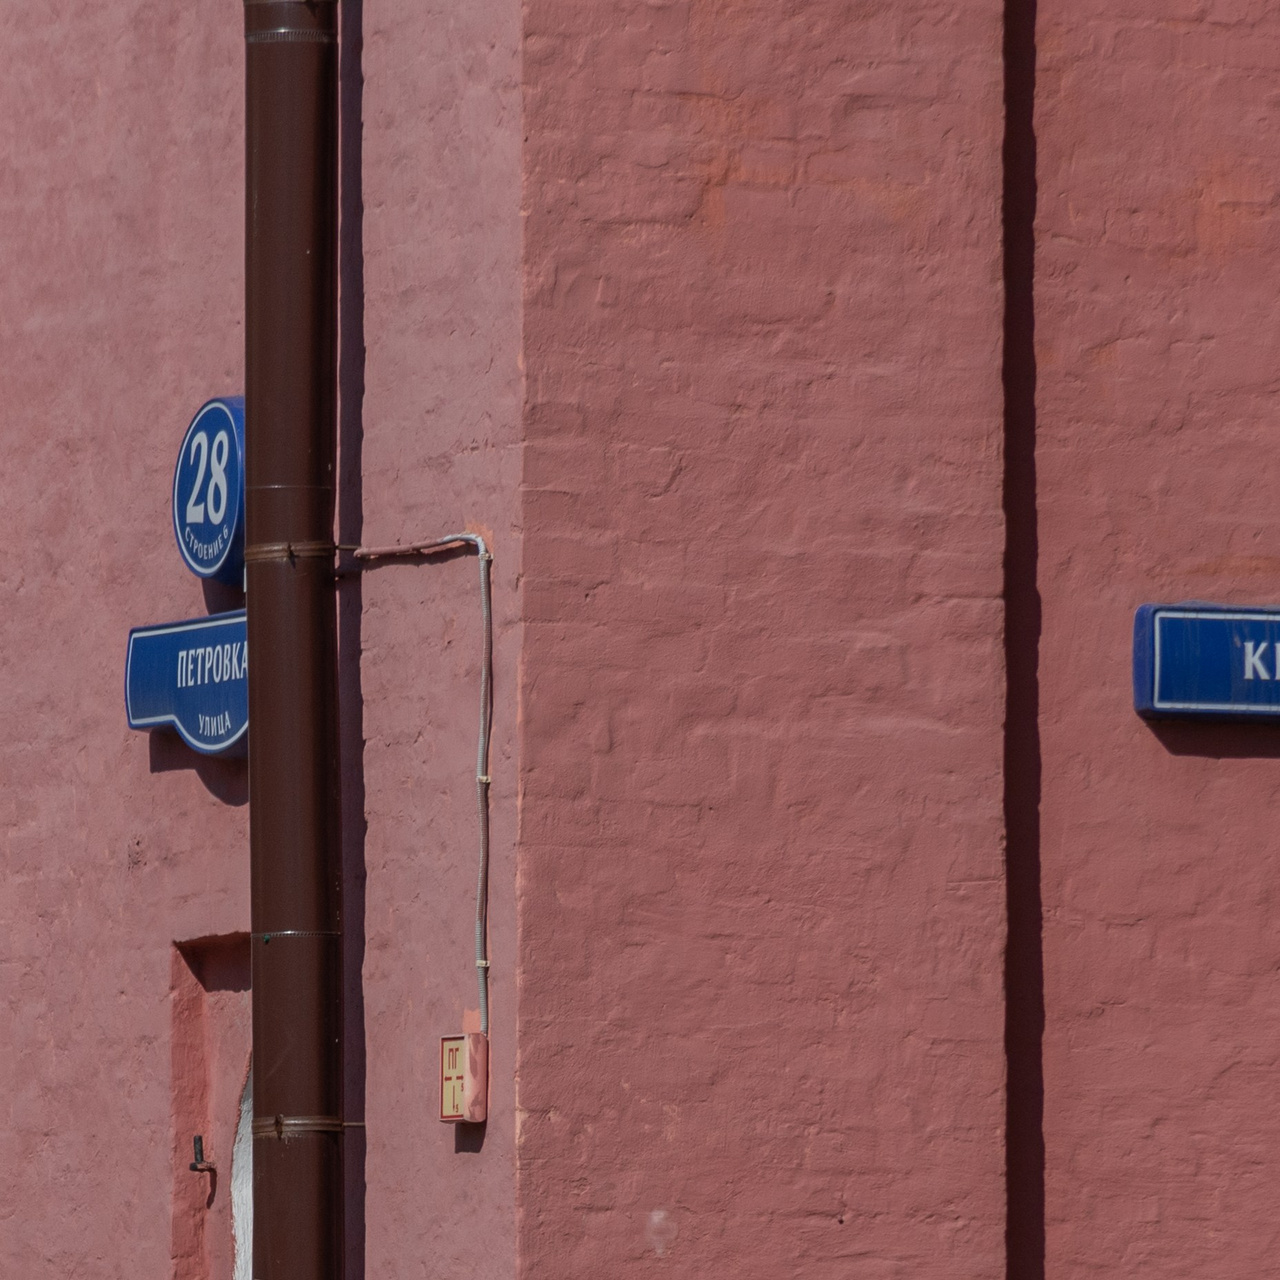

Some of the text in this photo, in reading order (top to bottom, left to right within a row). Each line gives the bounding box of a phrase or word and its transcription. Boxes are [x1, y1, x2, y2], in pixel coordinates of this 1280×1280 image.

[186, 430, 228, 524] 28
[185, 527, 223, 559] СТРОЕНИЕ
[198, 712, 231, 736] УЛИЦА
